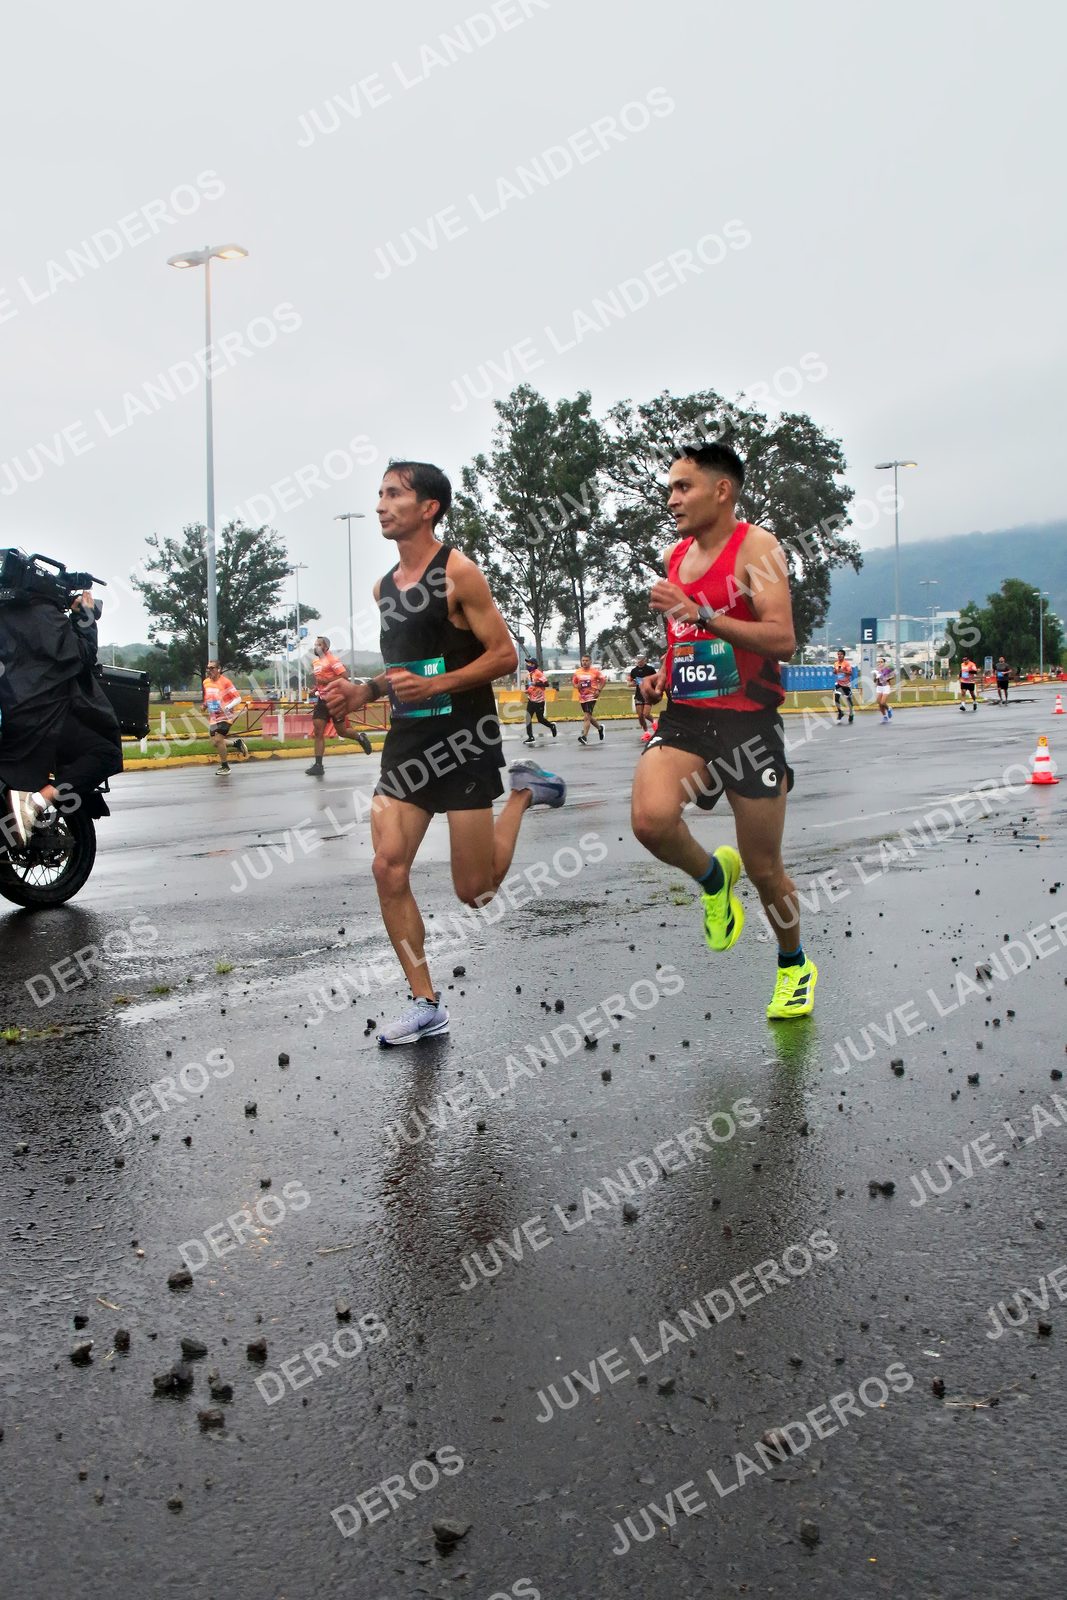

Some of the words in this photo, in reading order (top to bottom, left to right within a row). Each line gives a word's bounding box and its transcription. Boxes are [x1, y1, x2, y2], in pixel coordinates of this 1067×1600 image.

[864, 628, 872, 640] E
[710, 642, 726, 655] 10K
[424, 662, 438, 676] 10K
[679, 664, 717, 682] 1662
